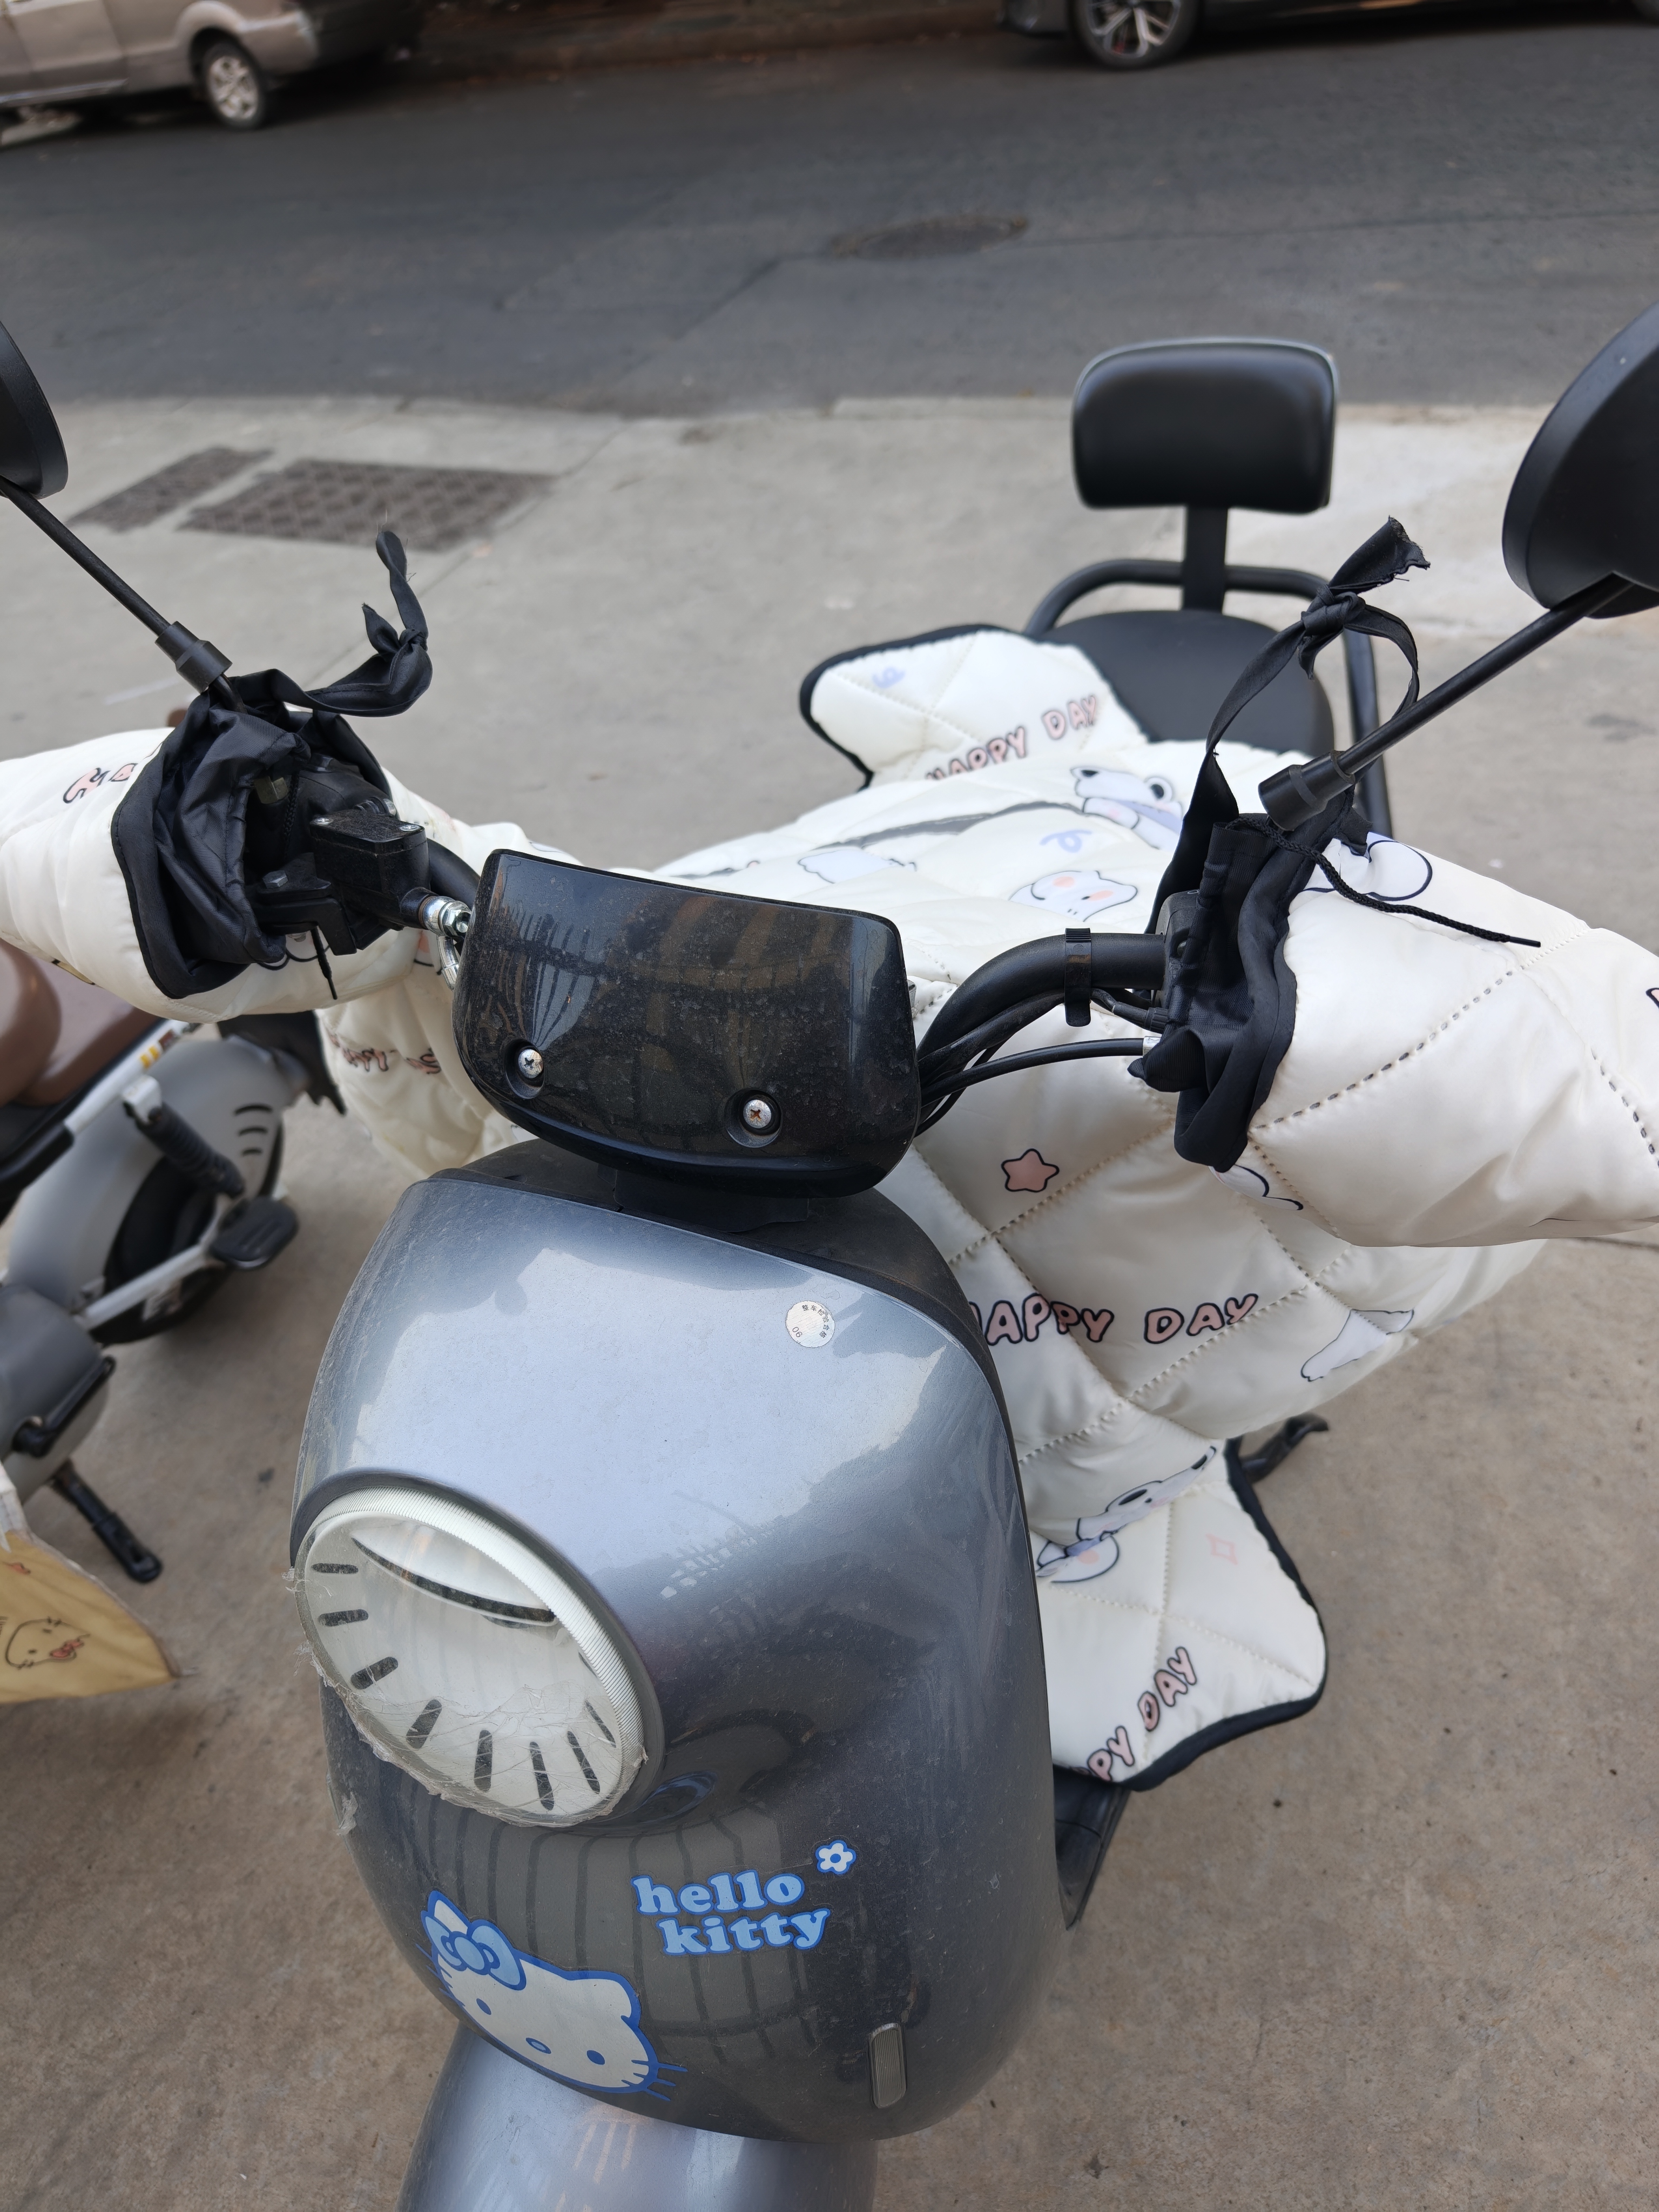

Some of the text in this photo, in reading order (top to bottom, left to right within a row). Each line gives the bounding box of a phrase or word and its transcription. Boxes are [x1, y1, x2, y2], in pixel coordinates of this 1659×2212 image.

[1041, 694, 1097, 740] DAY
[802, 1305, 830, 1338] 整车检验合格
[1143, 1293, 1259, 1344] DAY
[1137, 1646, 1197, 1732] DAY
[631, 1870, 805, 1914] hello
[657, 1908, 831, 1955] kitty
